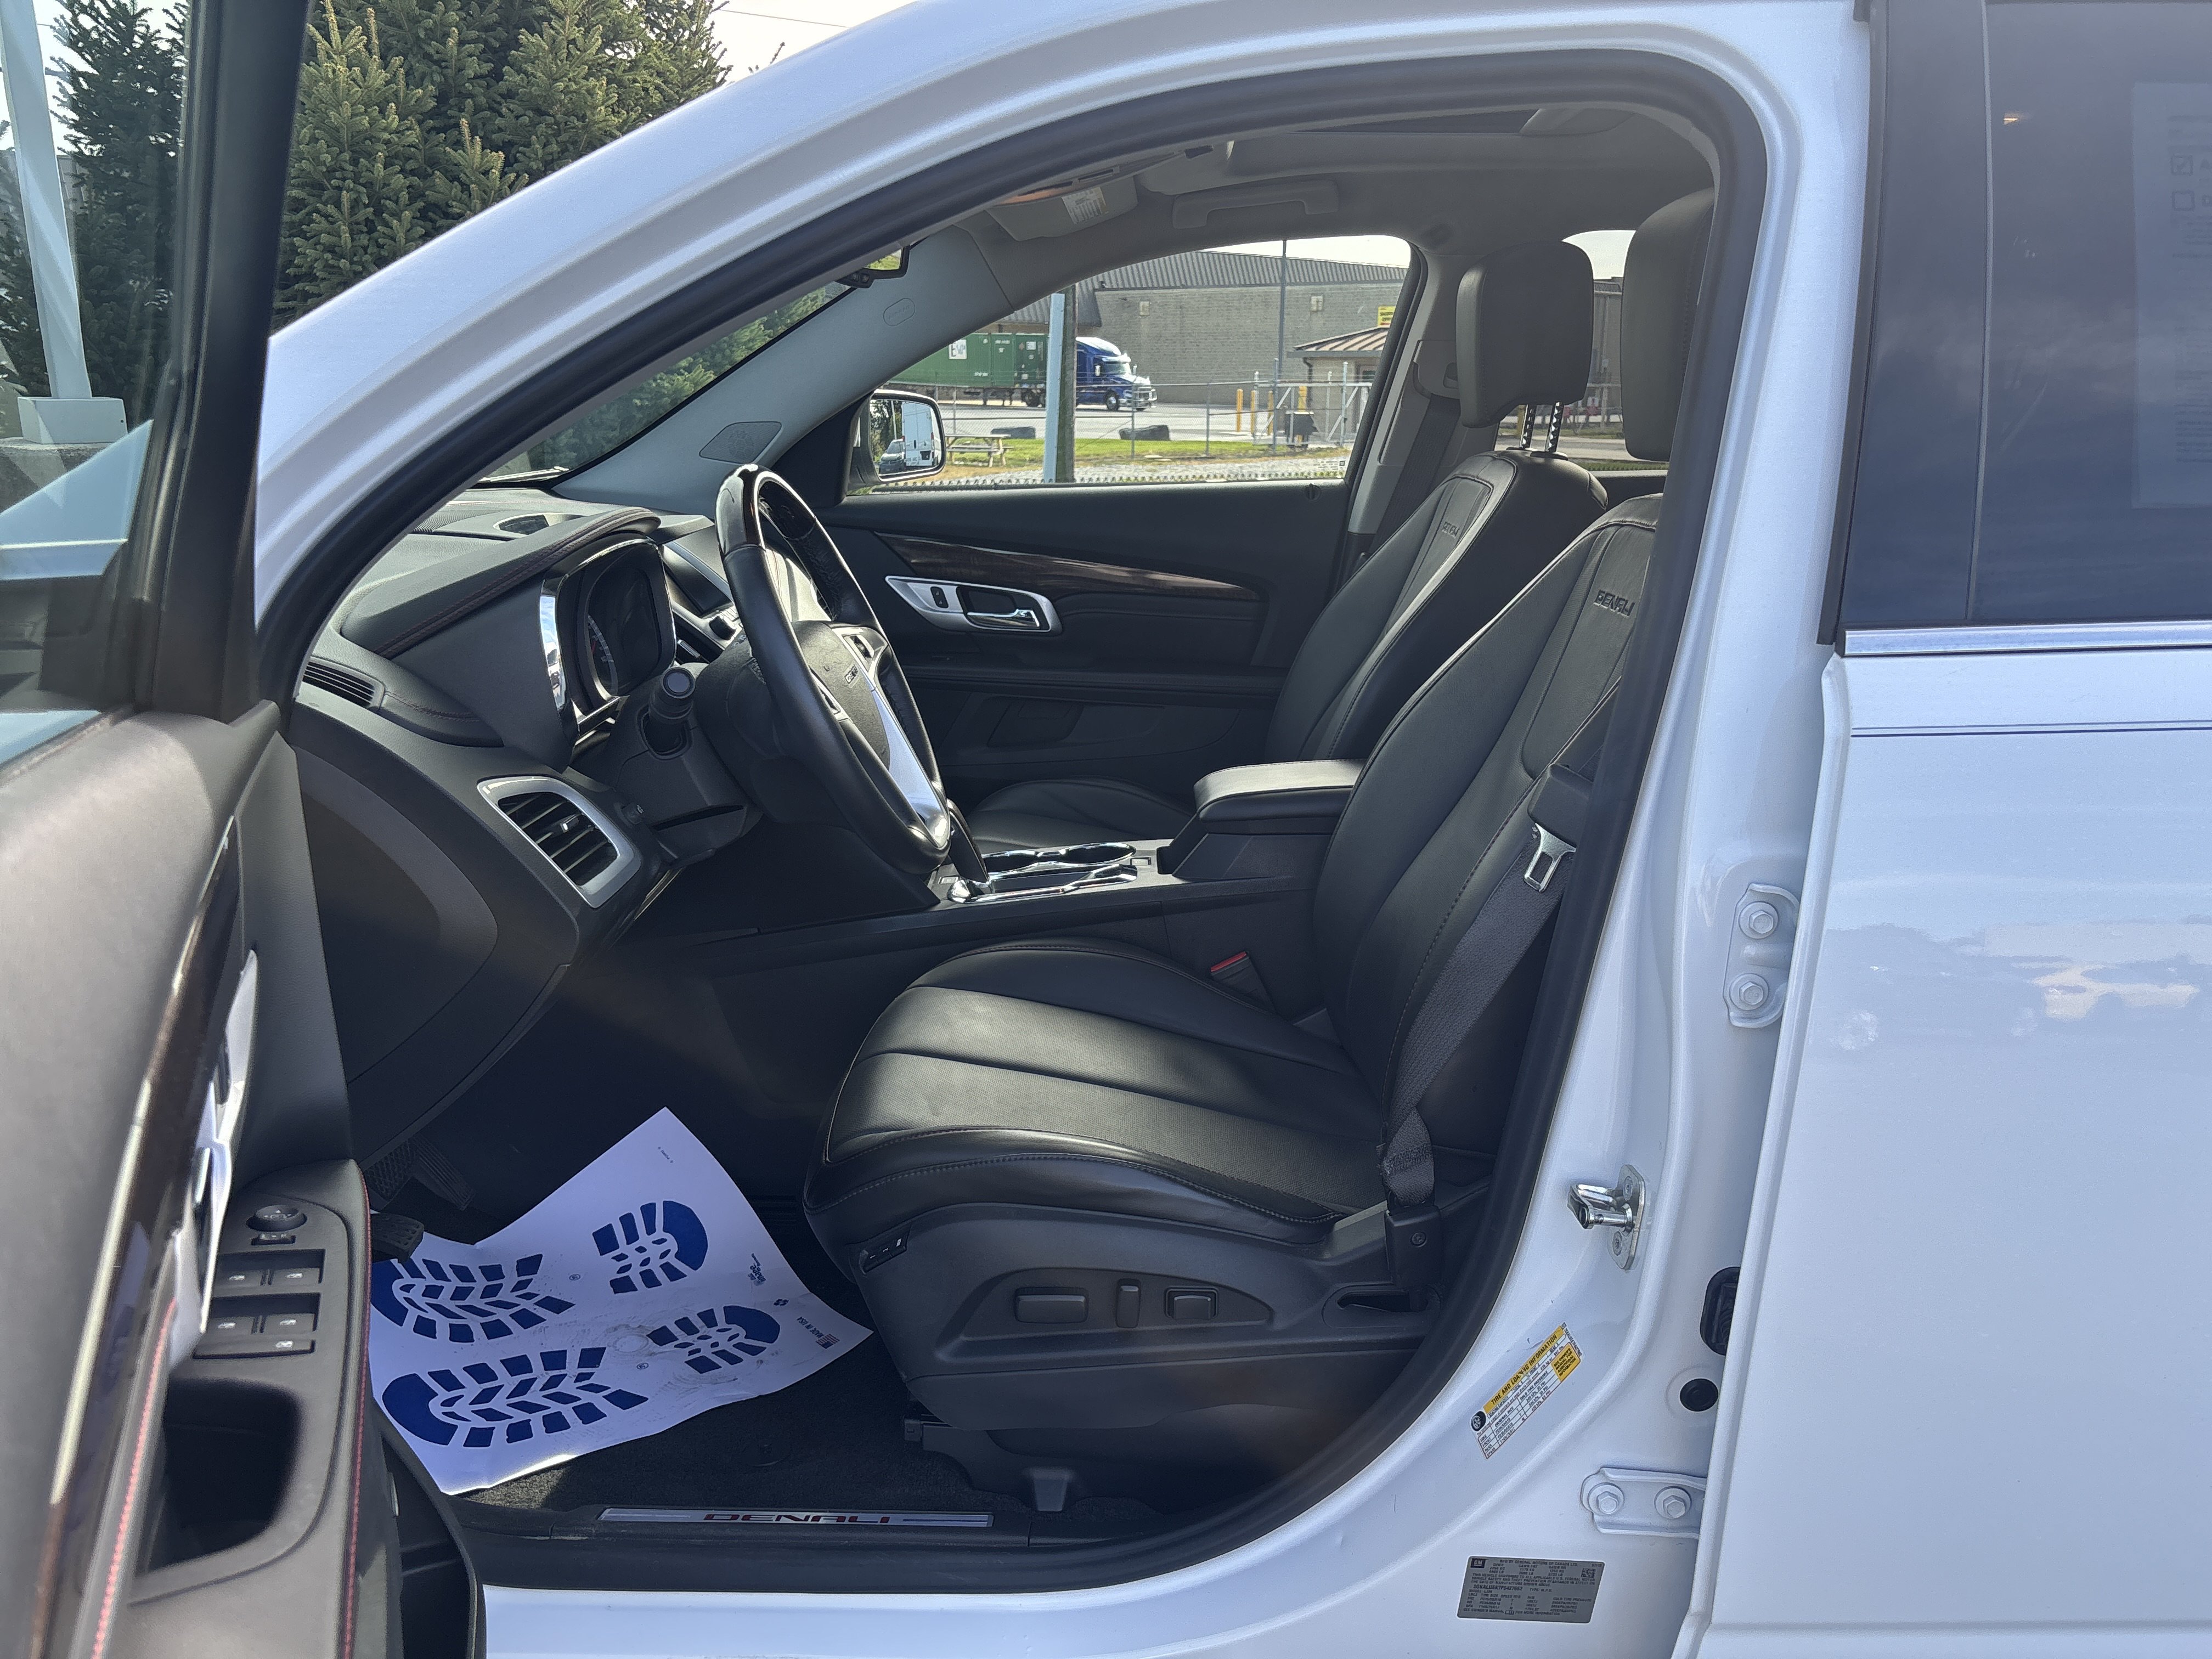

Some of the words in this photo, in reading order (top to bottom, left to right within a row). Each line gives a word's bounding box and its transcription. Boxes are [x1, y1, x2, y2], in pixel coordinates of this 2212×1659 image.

[1593, 589, 1635, 618] DENALI
[1491, 1392, 1502, 1406] TIRE
[1500, 1382, 1511, 1395] AND
[1528, 1333, 1557, 1366] INFORMATION
[703, 1514, 890, 1523] DENALI
